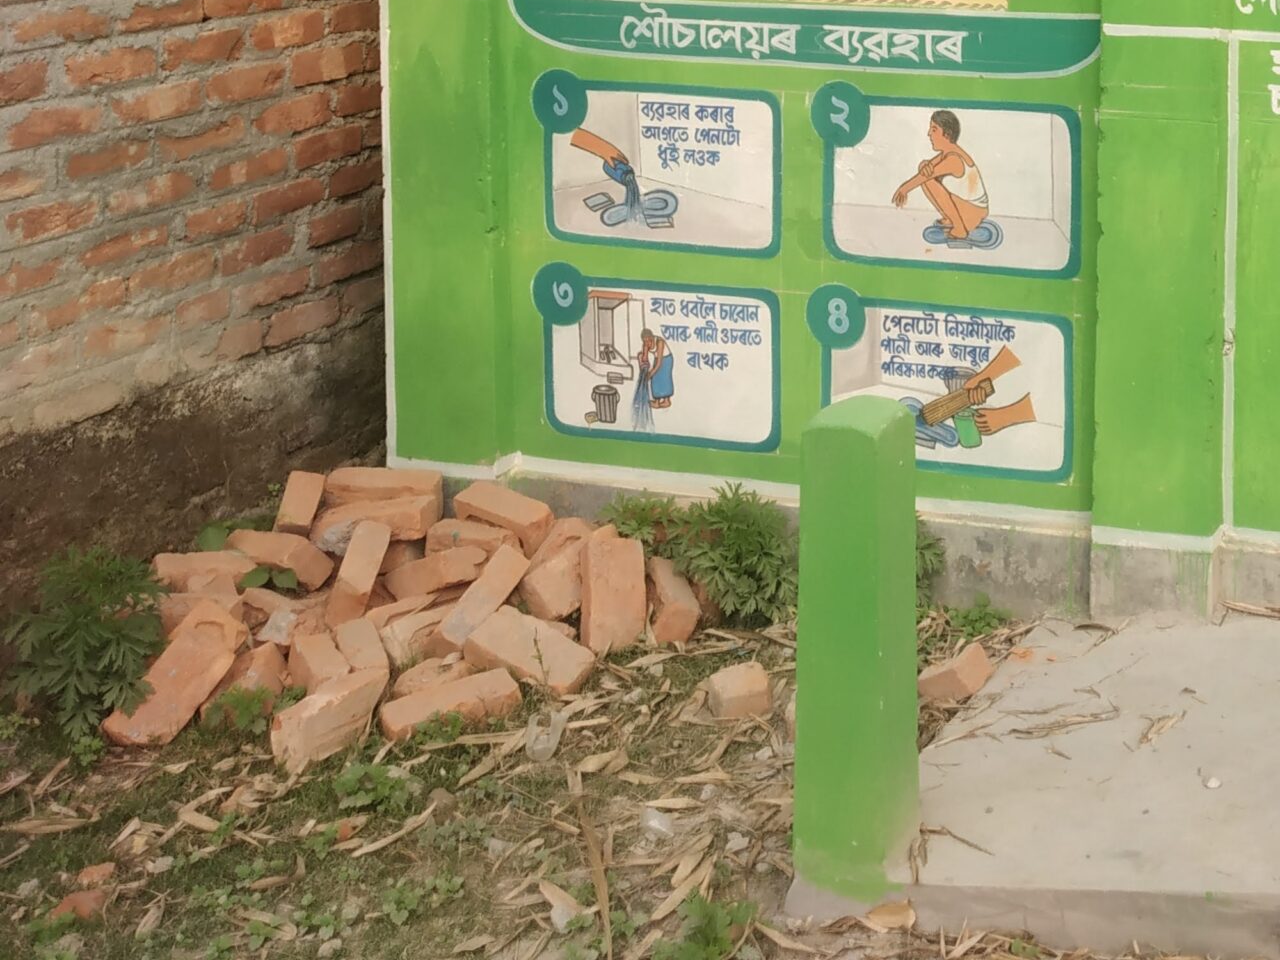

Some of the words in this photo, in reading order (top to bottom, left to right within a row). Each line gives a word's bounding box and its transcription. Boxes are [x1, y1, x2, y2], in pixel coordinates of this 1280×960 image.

[620, 2, 801, 59] শৌচালয়ৰ
[823, 24, 969, 64] ব্যৱহাৰ
[641, 125, 689, 142] আগতে
[658, 142, 680, 171] ধুই
[683, 149, 720, 166] লওক
[650, 297, 676, 316] হাত
